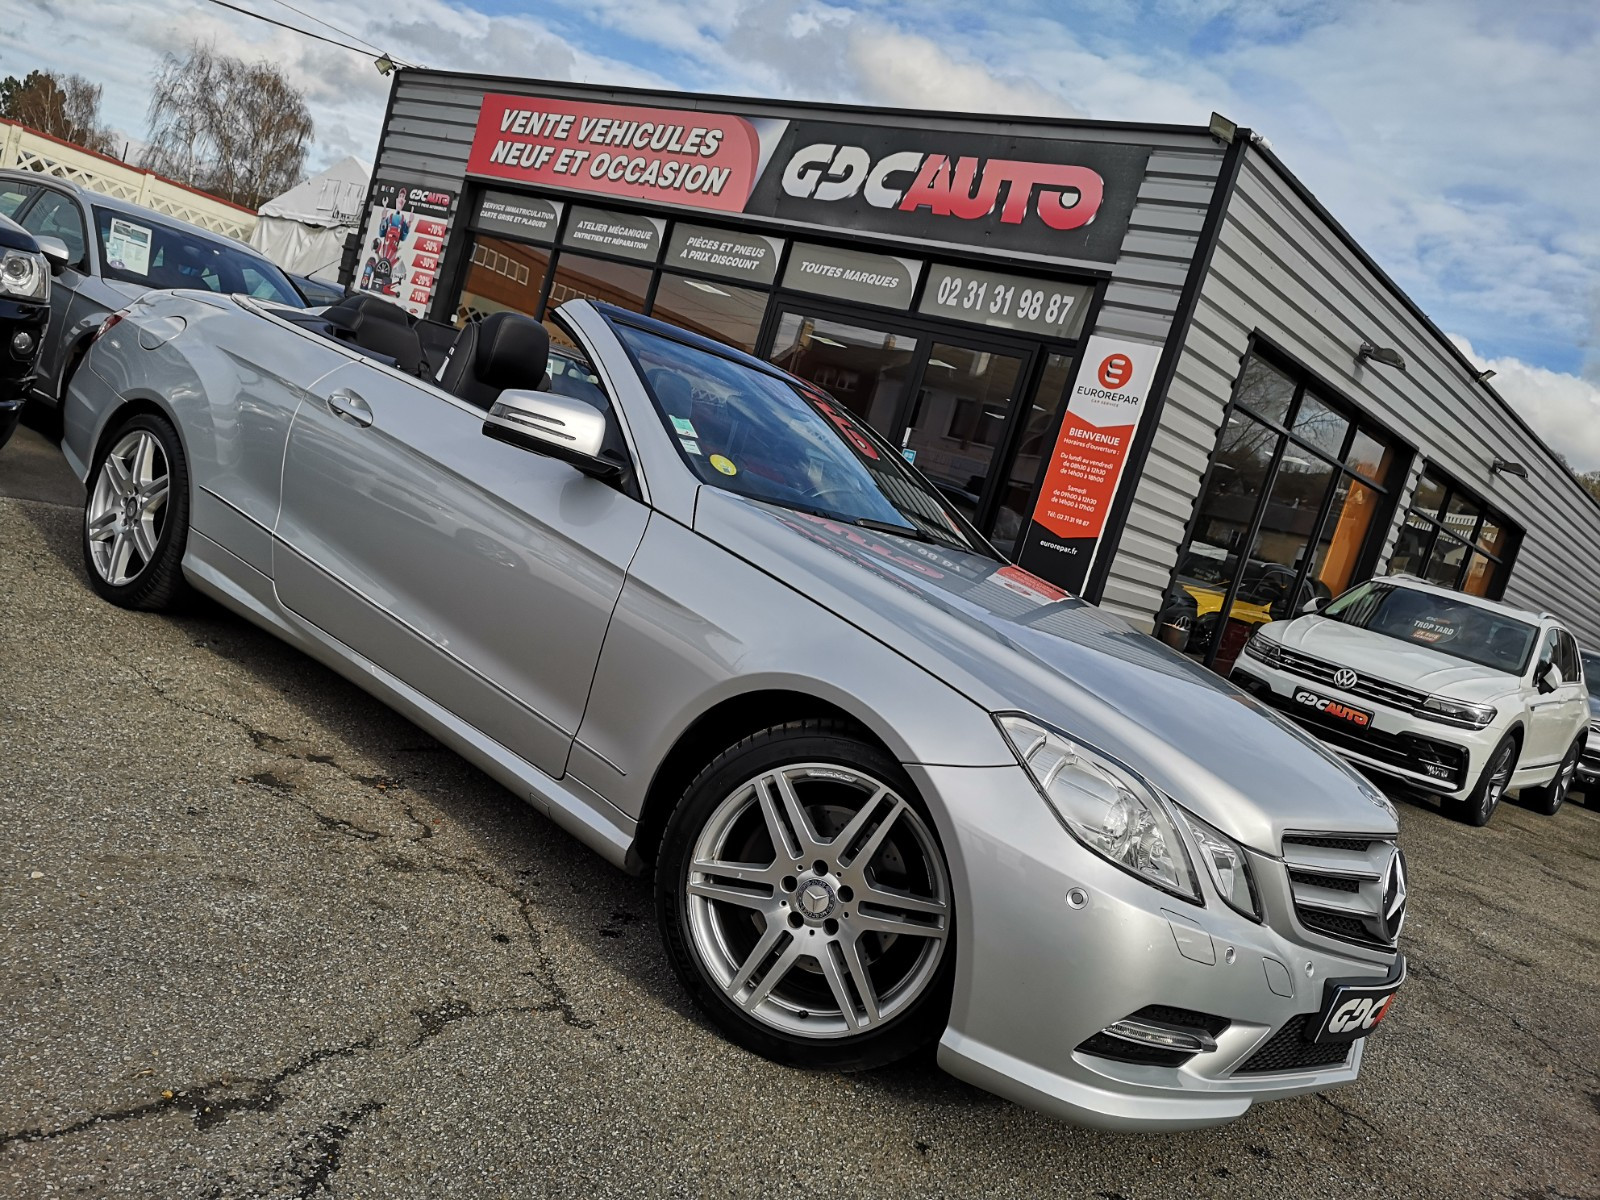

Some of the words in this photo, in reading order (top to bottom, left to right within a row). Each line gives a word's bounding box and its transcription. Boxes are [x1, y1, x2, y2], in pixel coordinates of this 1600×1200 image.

[500, 109, 576, 140] VENTE
[577, 117, 724, 156] VEHICULES
[490, 140, 555, 170] NEUF
[553, 149, 589, 175] ET
[589, 153, 731, 194] OCCASION
[480, 210, 498, 219] CARTE
[497, 213, 514, 222] GRISE
[521, 218, 548, 228] PLAQUES
[482, 202, 506, 212] SERVICE
[505, 205, 556, 220] IMMATRICULATION
[577, 220, 608, 232] ATELIER
[607, 224, 653, 240] MÉCANIQUE
[573, 231, 604, 242] ENTRETIEN
[604, 236, 612, 244] ET
[612, 238, 648, 250] RÉPARATION
[686, 236, 720, 250] PIÈCES
[719, 242, 734, 253] ET
[732, 244, 766, 258] PNEUS
[680, 248, 688, 258] A
[688, 250, 712, 262] PRIX
[710, 254, 760, 270] DISCOUNT
[800, 261, 843, 278] TOUTES
[842, 269, 899, 288] MARQUES
[937, 276, 964, 307] 02
[963, 280, 989, 311] 31
[988, 283, 1016, 315] 31
[1016, 289, 1045, 321] 98
[1044, 293, 1075, 325] 87
[1077, 386, 1139, 406] EUROREPAR
[1068, 427, 1120, 446] BIENVENUE
[1063, 438, 1086, 448] Horaires
[1086, 442, 1117, 455] d'ouverture
[1068, 453, 1082, 462] lundi
[1090, 458, 1114, 470] vendredi
[1068, 469, 1084, 478] 14h00
[1068, 484, 1087, 494] Samedi
[1058, 498, 1074, 506] 14h00
[1079, 503, 1094, 512] 17h00
[1039, 538, 1078, 556] eurorepar.fr
[1413, 620, 1434, 630] TROP
[1434, 624, 1454, 635] TARD
